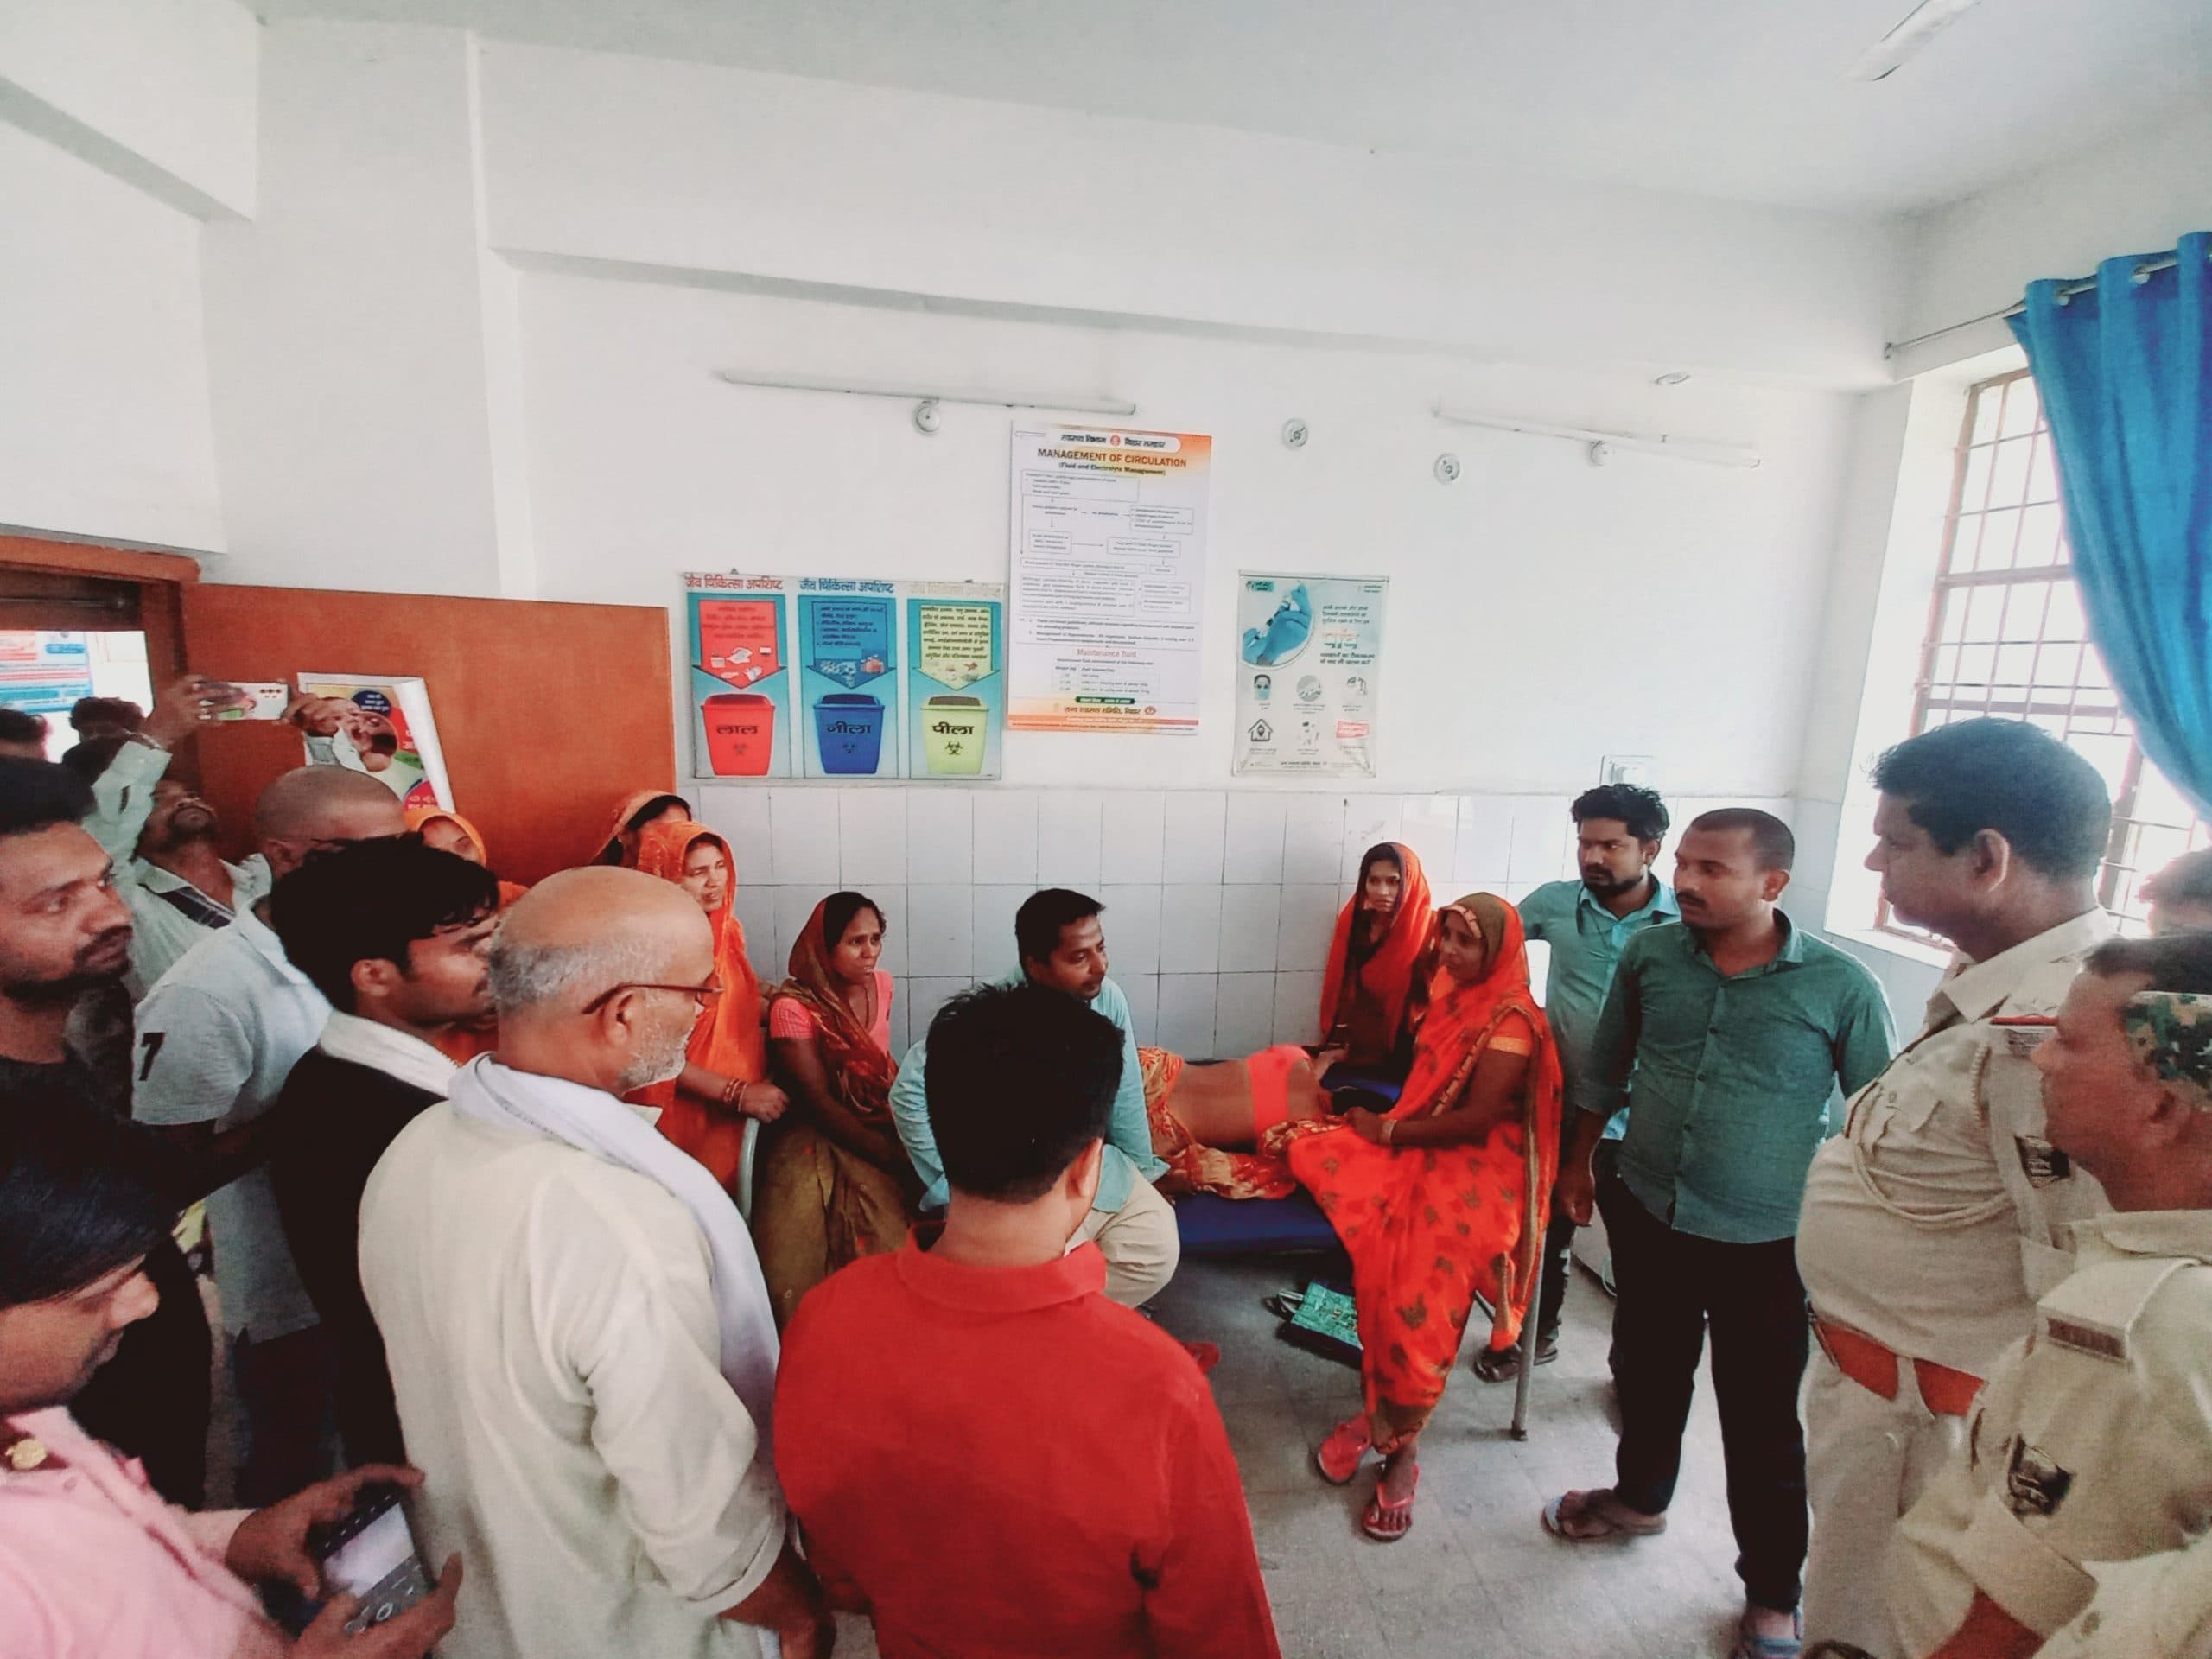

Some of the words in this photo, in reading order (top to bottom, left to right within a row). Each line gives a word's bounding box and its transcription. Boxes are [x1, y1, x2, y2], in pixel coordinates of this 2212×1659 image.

[1038, 448, 1107, 462] MANAGEMENT
[1109, 454, 1122, 463] OF
[1124, 454, 1187, 467] CIRCULATION
[685, 574, 702, 588] जैव
[705, 574, 743, 589] चिकित्सा
[747, 575, 783, 590] अपशिष्ट
[799, 577, 817, 590] जैव
[818, 577, 857, 592] चिकित्सा
[858, 580, 894, 594] अपशिष्ट
[1077, 649, 1119, 658] Maintenance
[716, 724, 758, 734] लाल
[826, 721, 871, 734] नीला
[932, 721, 975, 734] पीला
[139, 1032, 166, 1081] 7
